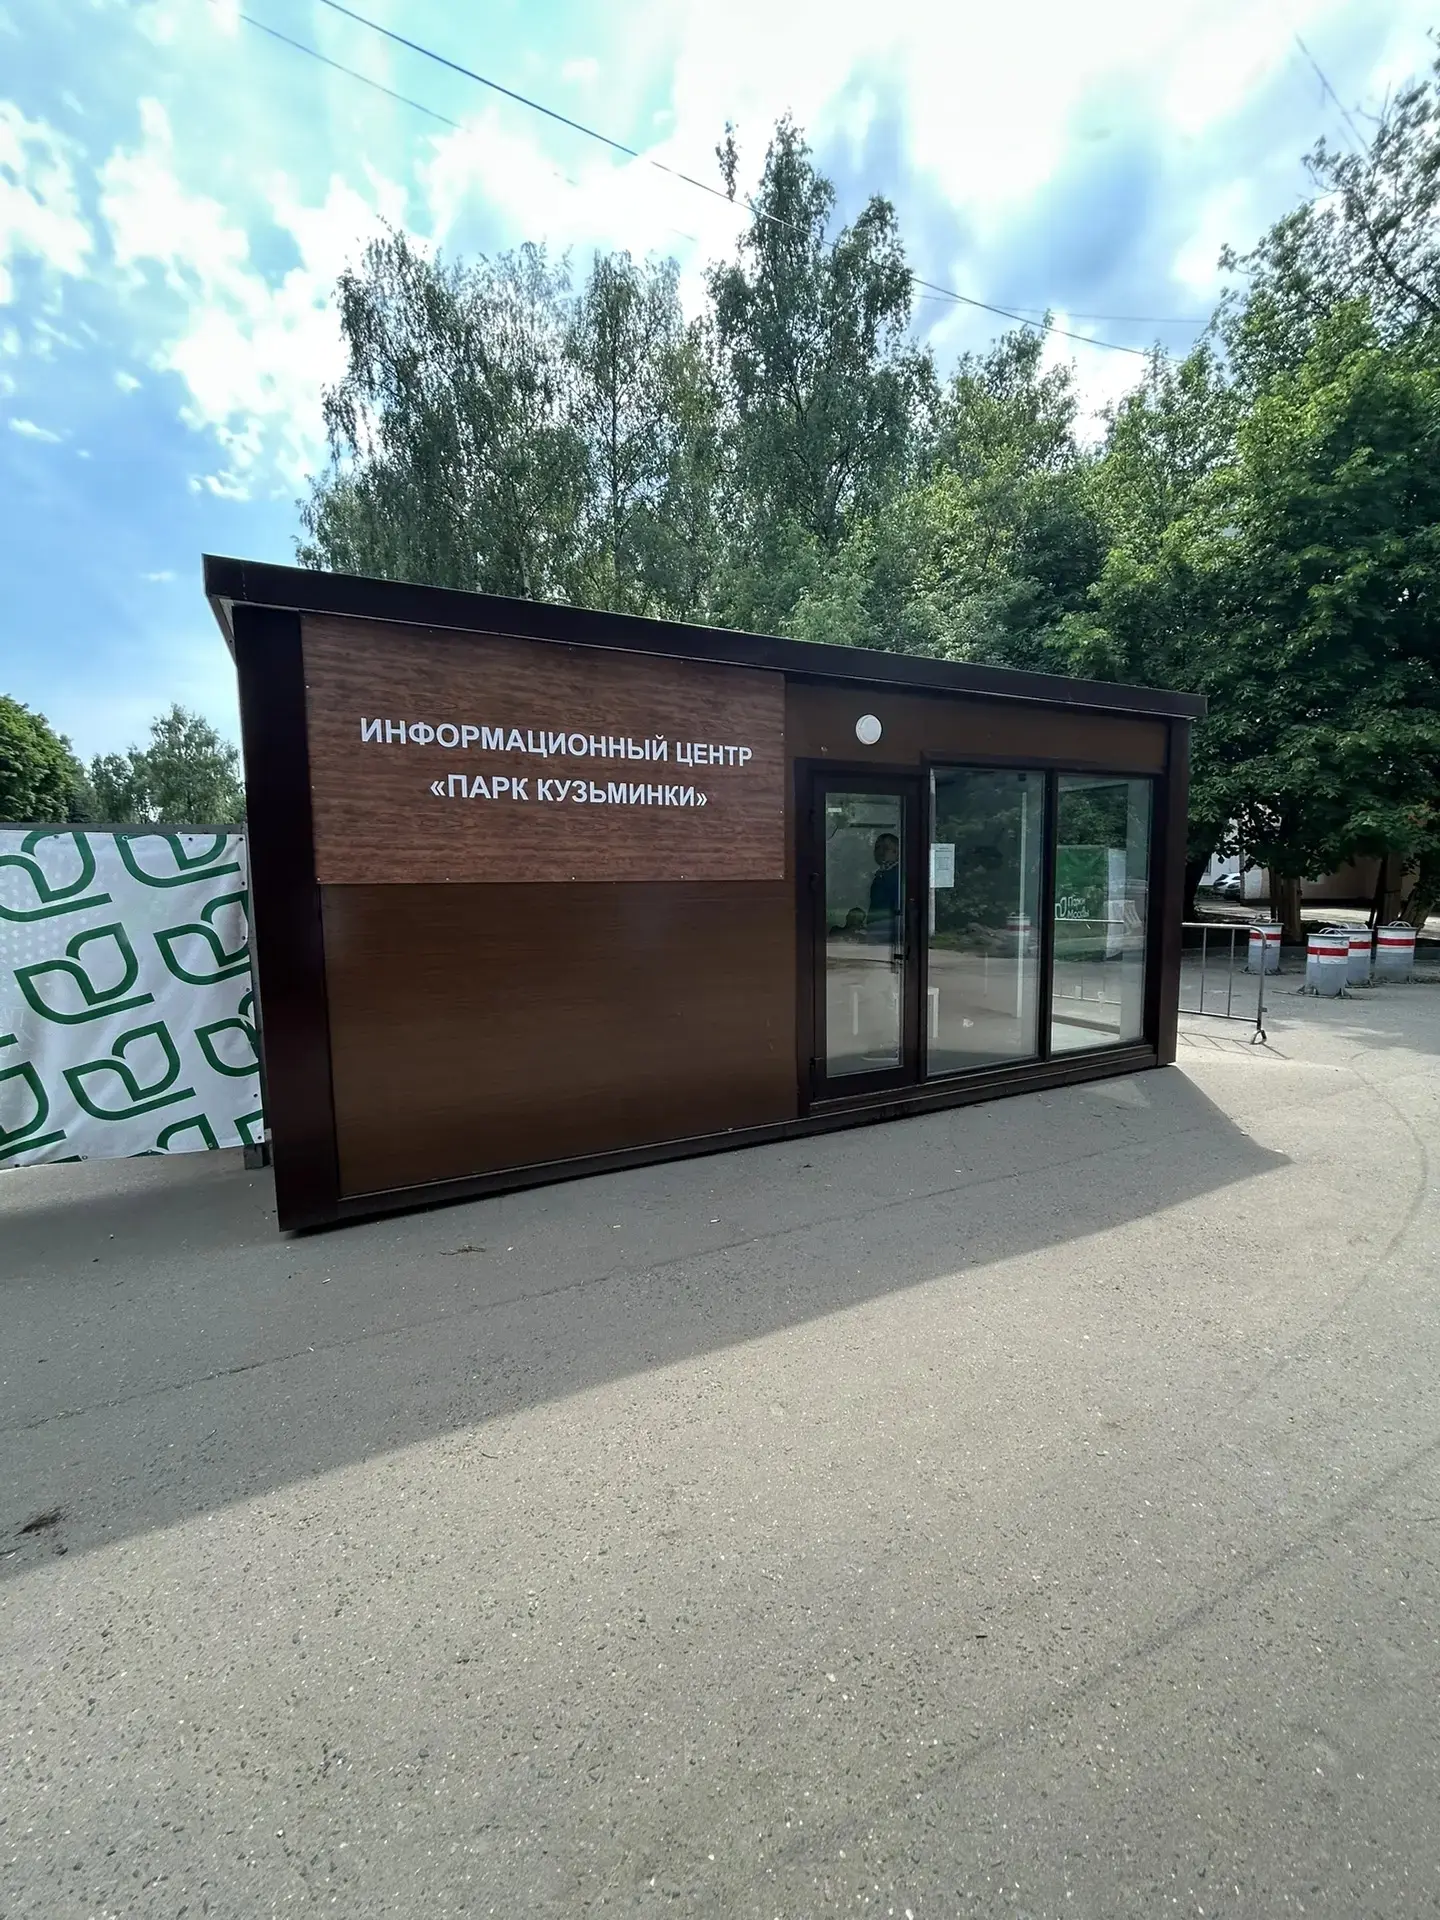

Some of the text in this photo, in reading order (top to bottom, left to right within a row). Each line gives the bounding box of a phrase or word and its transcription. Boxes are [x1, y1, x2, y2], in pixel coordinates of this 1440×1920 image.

[360, 717, 753, 768] ИНФОРМАЦИОННЫЙ ЦЕНТР
[430, 773, 709, 807] «ПАРК КУЗЬМИНКИ»
